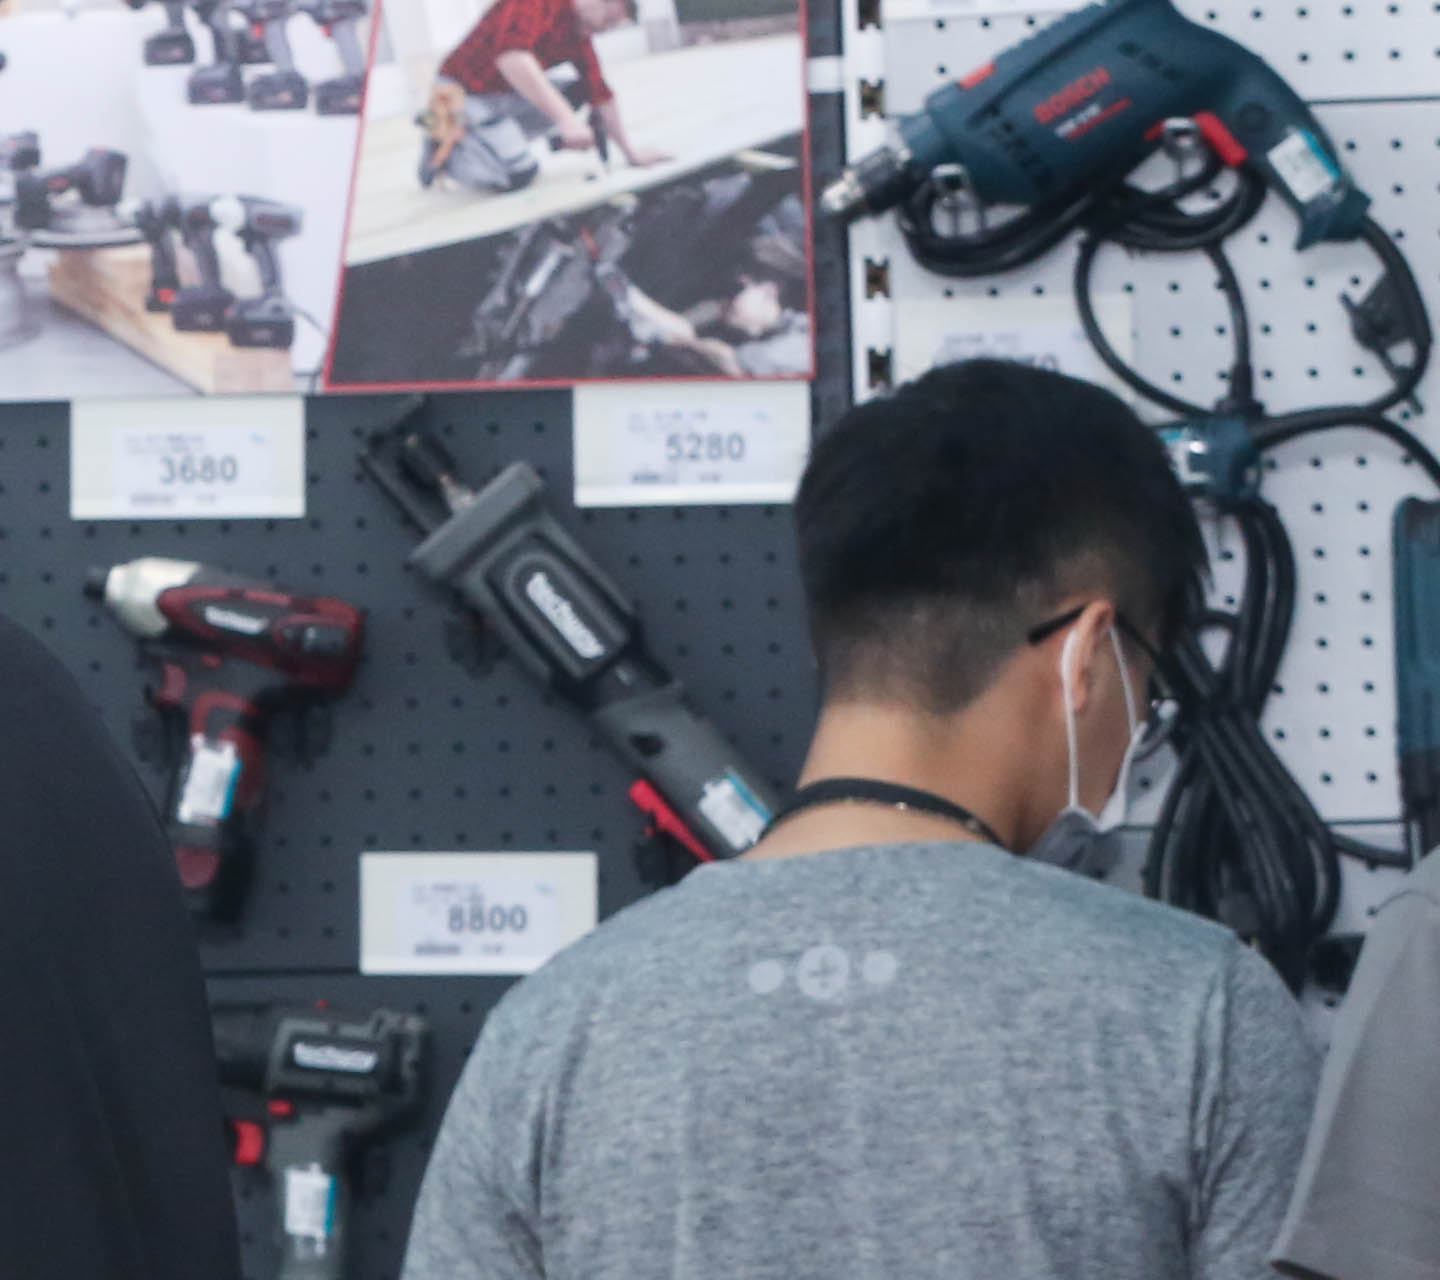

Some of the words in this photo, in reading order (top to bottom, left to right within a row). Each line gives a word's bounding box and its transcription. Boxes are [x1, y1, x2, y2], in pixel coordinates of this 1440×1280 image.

[1033, 67, 1111, 125] BOSCH
[664, 432, 746, 464] 5280
[158, 455, 240, 485] 3680
[446, 903, 529, 935] 8800
